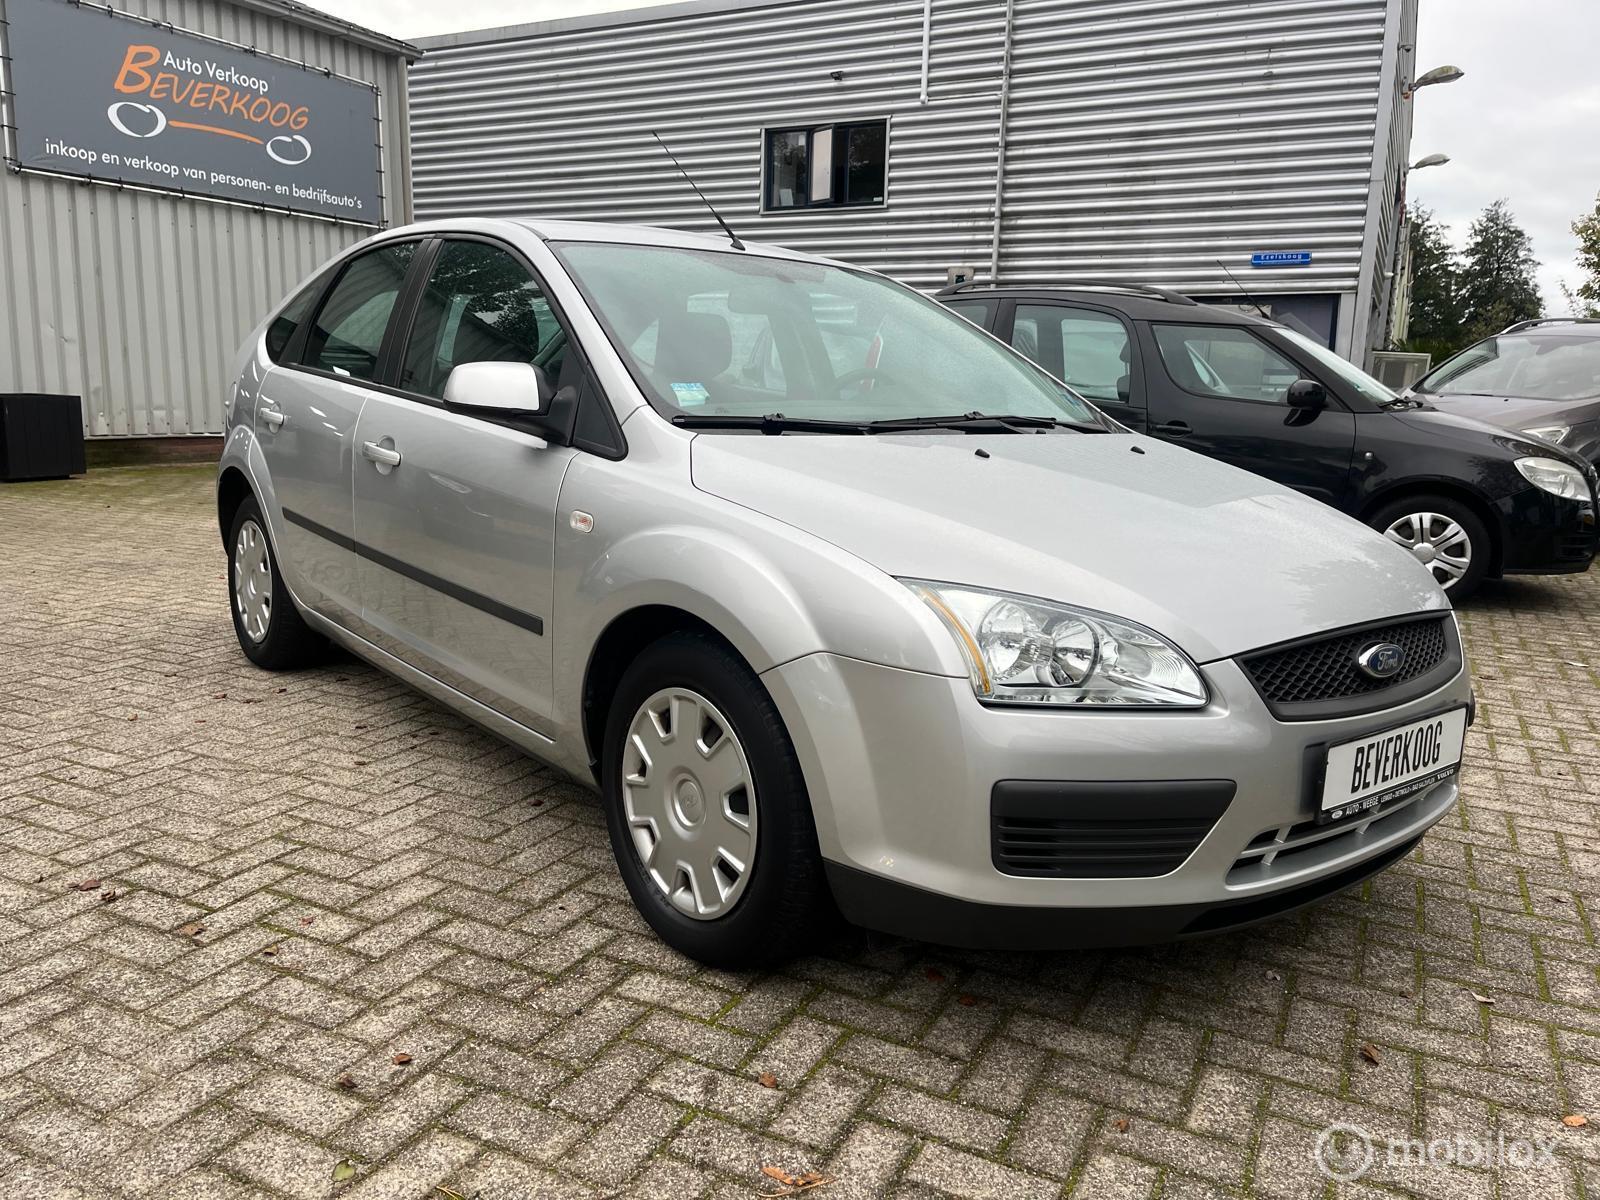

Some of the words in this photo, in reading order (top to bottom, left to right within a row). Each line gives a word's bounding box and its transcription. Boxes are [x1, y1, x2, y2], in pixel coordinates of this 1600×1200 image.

[114, 44, 309, 130] BEVERKOOG
[163, 51, 202, 75] Auto
[205, 61, 268, 94] Verkoop
[45, 138, 97, 164] inkoop
[101, 153, 120, 165] en
[123, 156, 179, 178] verkoop
[182, 167, 207, 180] van
[210, 172, 271, 191] personen-
[275, 184, 289, 195] en
[292, 184, 362, 209] bedrijfsauto's
[1377, 650, 1399, 671] Ford
[1350, 720, 1443, 794] BEVERKOOG
[1345, 803, 1360, 816] AUTO
